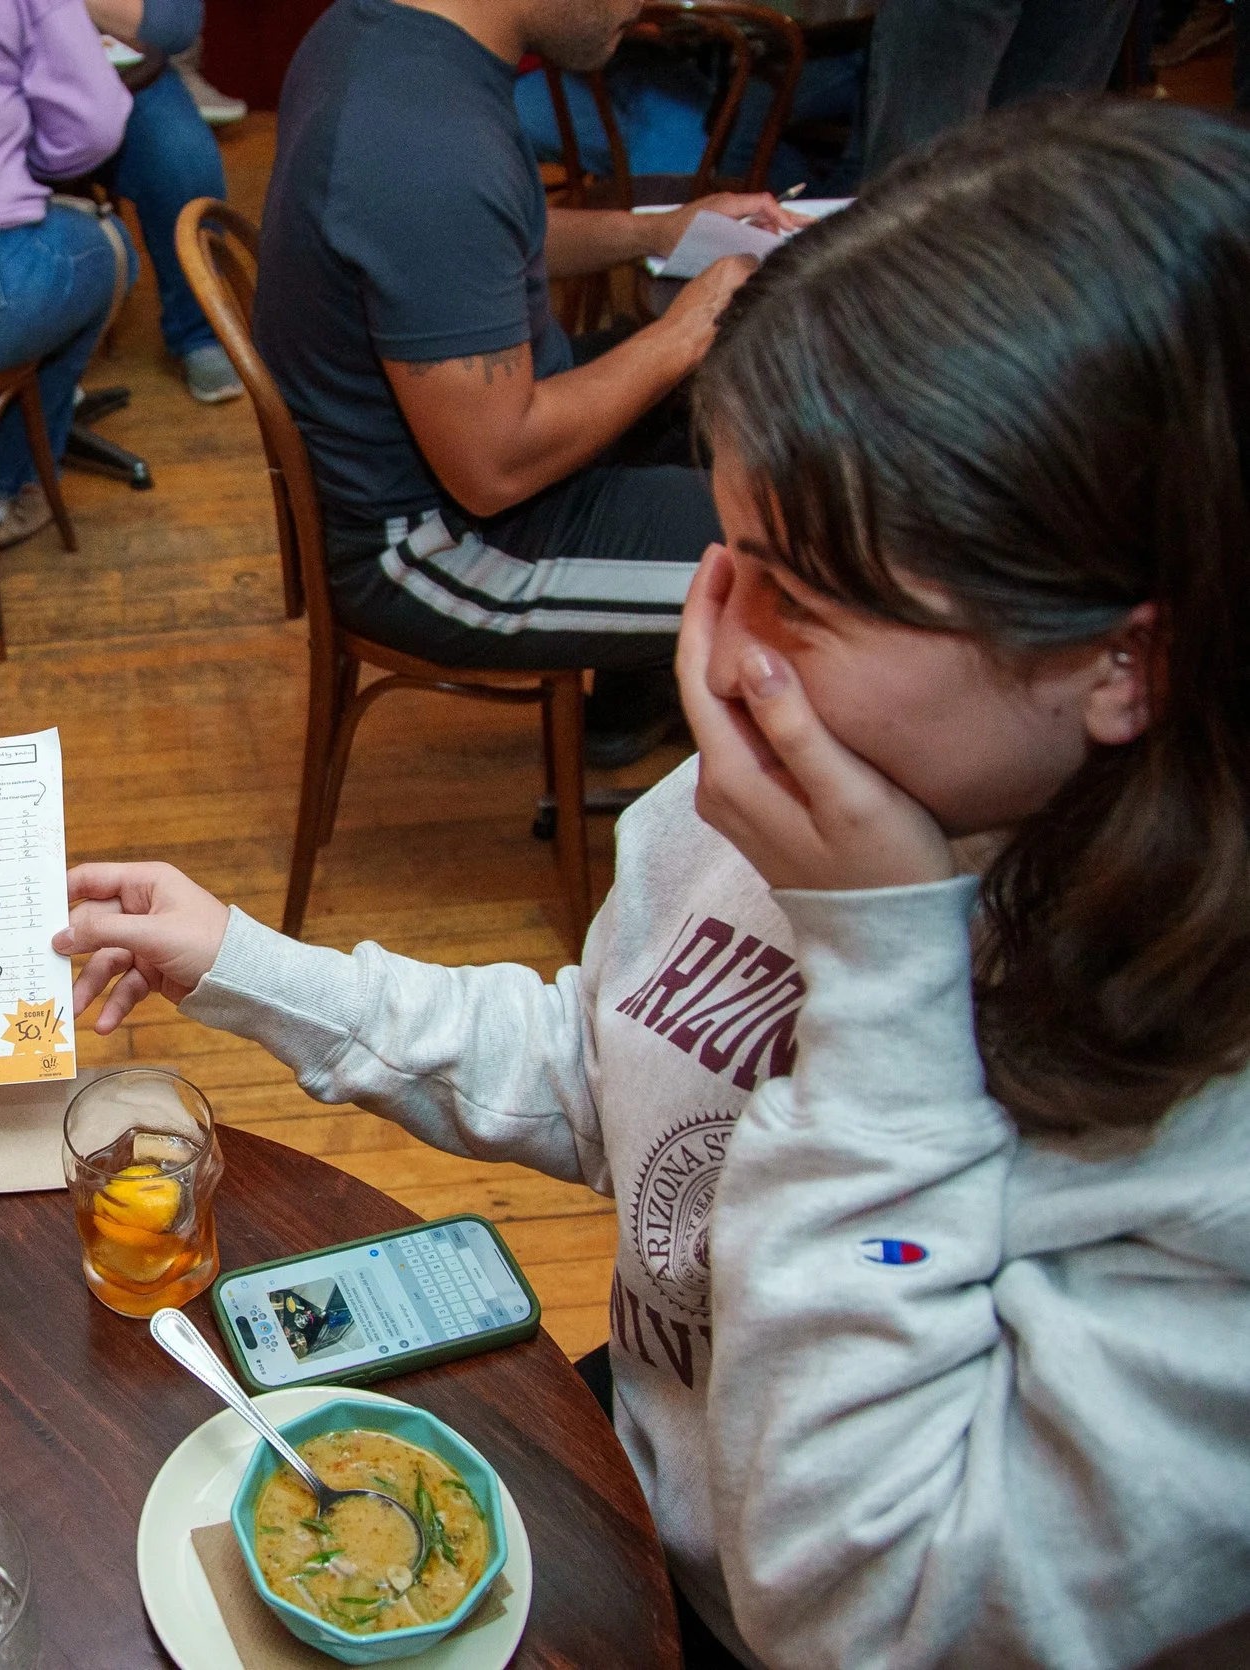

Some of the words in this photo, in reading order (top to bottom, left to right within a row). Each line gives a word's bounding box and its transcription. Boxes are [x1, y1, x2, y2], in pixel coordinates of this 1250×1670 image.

[43, 1058, 56, 1068] Q!!
[615, 913, 807, 1092] ARIZON
[646, 1144, 705, 1285] ARIZONA
